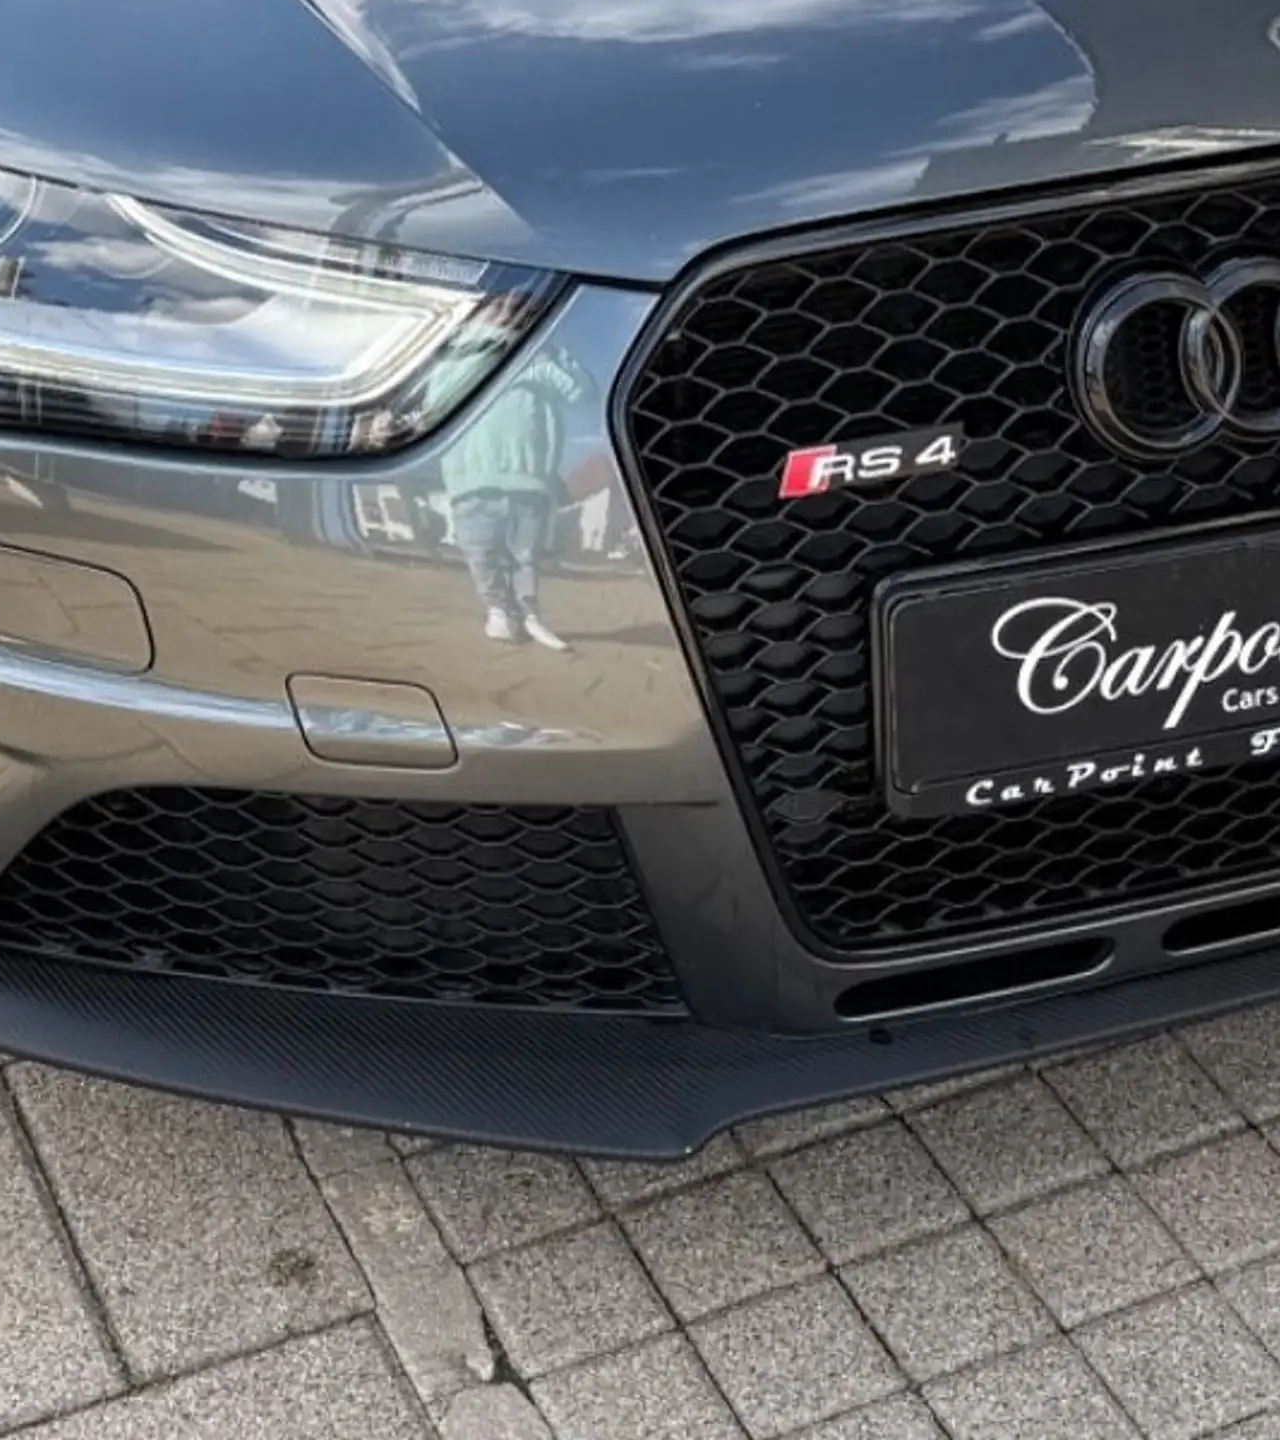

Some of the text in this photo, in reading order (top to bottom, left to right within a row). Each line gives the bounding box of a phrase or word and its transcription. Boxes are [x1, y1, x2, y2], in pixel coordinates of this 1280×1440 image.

[807, 434, 956, 491] RS 4
[1221, 683, 1280, 714] Cars
